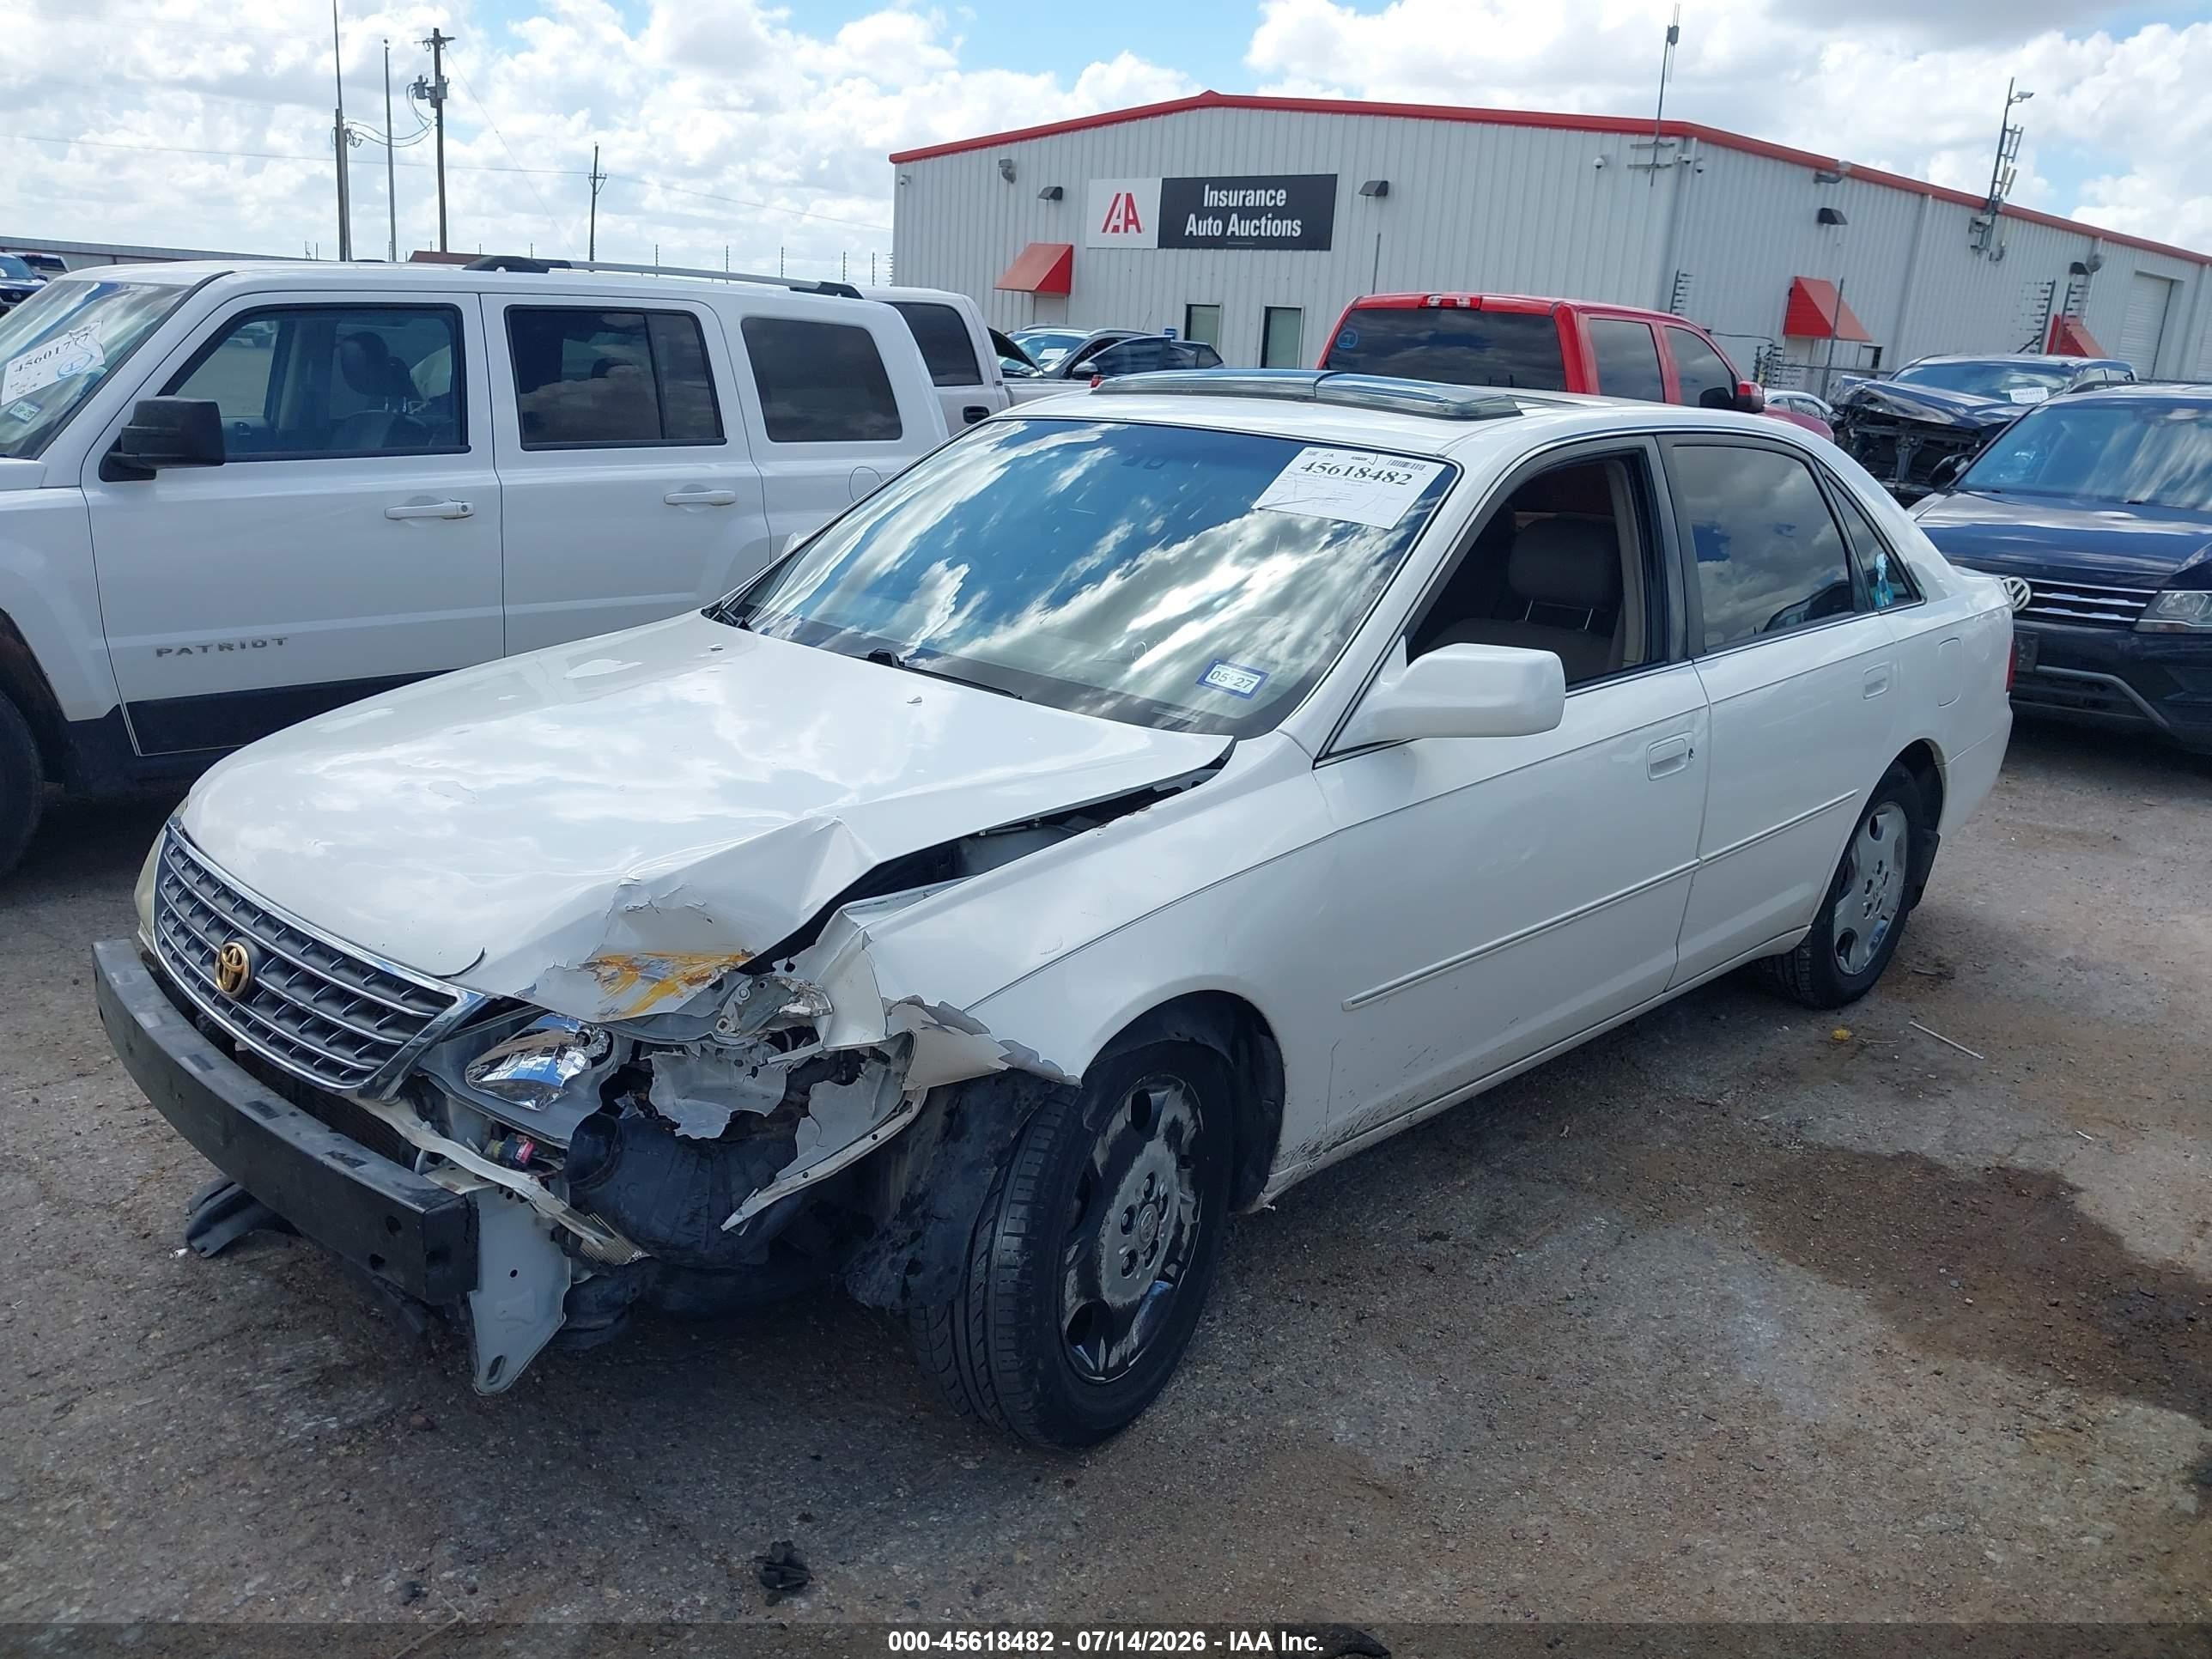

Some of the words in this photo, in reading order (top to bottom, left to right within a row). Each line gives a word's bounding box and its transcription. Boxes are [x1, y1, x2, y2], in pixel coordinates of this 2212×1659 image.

[1203, 184, 1287, 208] Insurance
[1184, 213, 1223, 237] Auto
[1226, 212, 1302, 237] Auctions
[1300, 461, 1413, 485] 45618482
[156, 637, 288, 657] PATRIOT
